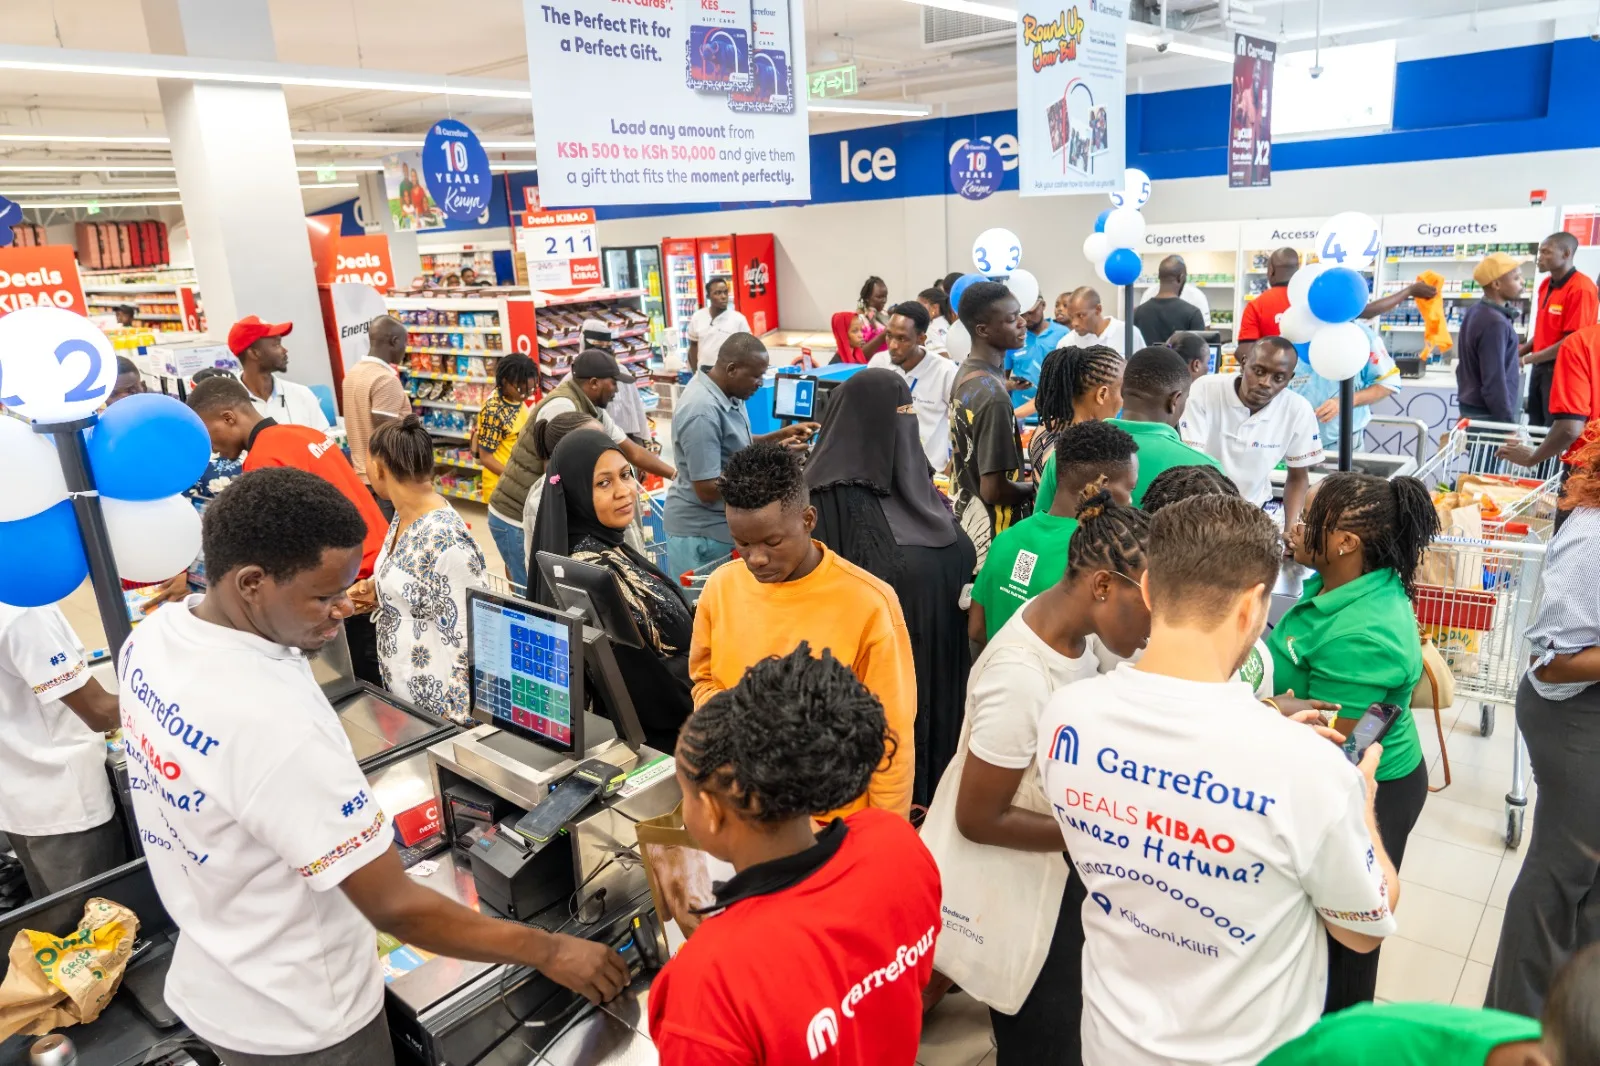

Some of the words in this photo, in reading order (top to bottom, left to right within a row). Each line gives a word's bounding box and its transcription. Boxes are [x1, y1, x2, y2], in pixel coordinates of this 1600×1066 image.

[701, 0, 719, 10] KES
[541, 5, 571, 25] The
[574, 10, 627, 33] Perfect
[629, 18, 649, 36] Fit
[651, 20, 671, 38] for
[1023, 10, 1066, 46] Round
[1067, 5, 1084, 44] Up
[560, 38, 571, 52] a
[574, 36, 627, 58] Perfect
[630, 43, 662, 62] Gift.
[1033, 41, 1059, 73] Your
[1058, 38, 1076, 63] Bill
[611, 118, 646, 135] Load
[649, 123, 675, 140] any
[678, 124, 726, 138] amount
[728, 124, 755, 139] from
[441, 140, 468, 172] 10
[557, 141, 589, 159] KSh
[591, 143, 620, 159] 500
[623, 145, 639, 159] to
[641, 143, 669, 160] KSh
[671, 145, 716, 162] 50,000
[719, 147, 742, 161] and
[744, 148, 767, 164] give
[769, 148, 796, 162] them
[840, 140, 896, 183] Ice
[966, 152, 987, 171] 10
[1254, 140, 1270, 165] X2
[435, 172, 480, 184] YEARS
[566, 171, 577, 184] a
[581, 168, 607, 187] gift
[610, 168, 640, 184] that
[642, 168, 664, 184] fits
[666, 169, 688, 183] the
[690, 170, 740, 183] moment
[742, 169, 795, 186] perfectly.
[959, 171, 993, 179] YEARS
[444, 185, 485, 214] Kenya
[961, 179, 993, 197] Kenya
[1138, 182, 1150, 204] 5
[527, 215, 555, 224] Deals
[555, 212, 589, 223] KIBAO
[1417, 223, 1497, 238] Cigarettes
[1145, 233, 1206, 246] Cigarettes
[1322, 232, 1347, 263] 4
[574, 264, 596, 272] Deals
[975, 247, 991, 272] 3
[1005, 245, 1020, 271] 3
[572, 271, 599, 280] KIBAO
[54, 338, 107, 403] 2
[49, 650, 68, 667] #3
[130, 667, 220, 757] Carrefour
[1096, 747, 1277, 817] Carrefour
[419, 821, 437, 834] next
[1065, 788, 1138, 826] DEALS
[1145, 811, 1235, 855] KIBAO
[1053, 803, 1130, 850] Tunazo
[1143, 835, 1265, 884] Hatuna?
[942, 905, 970, 923] Bedsure
[1119, 906, 1220, 958] Kibaoni,Kilifi
[841, 925, 935, 1018] Carrefour
